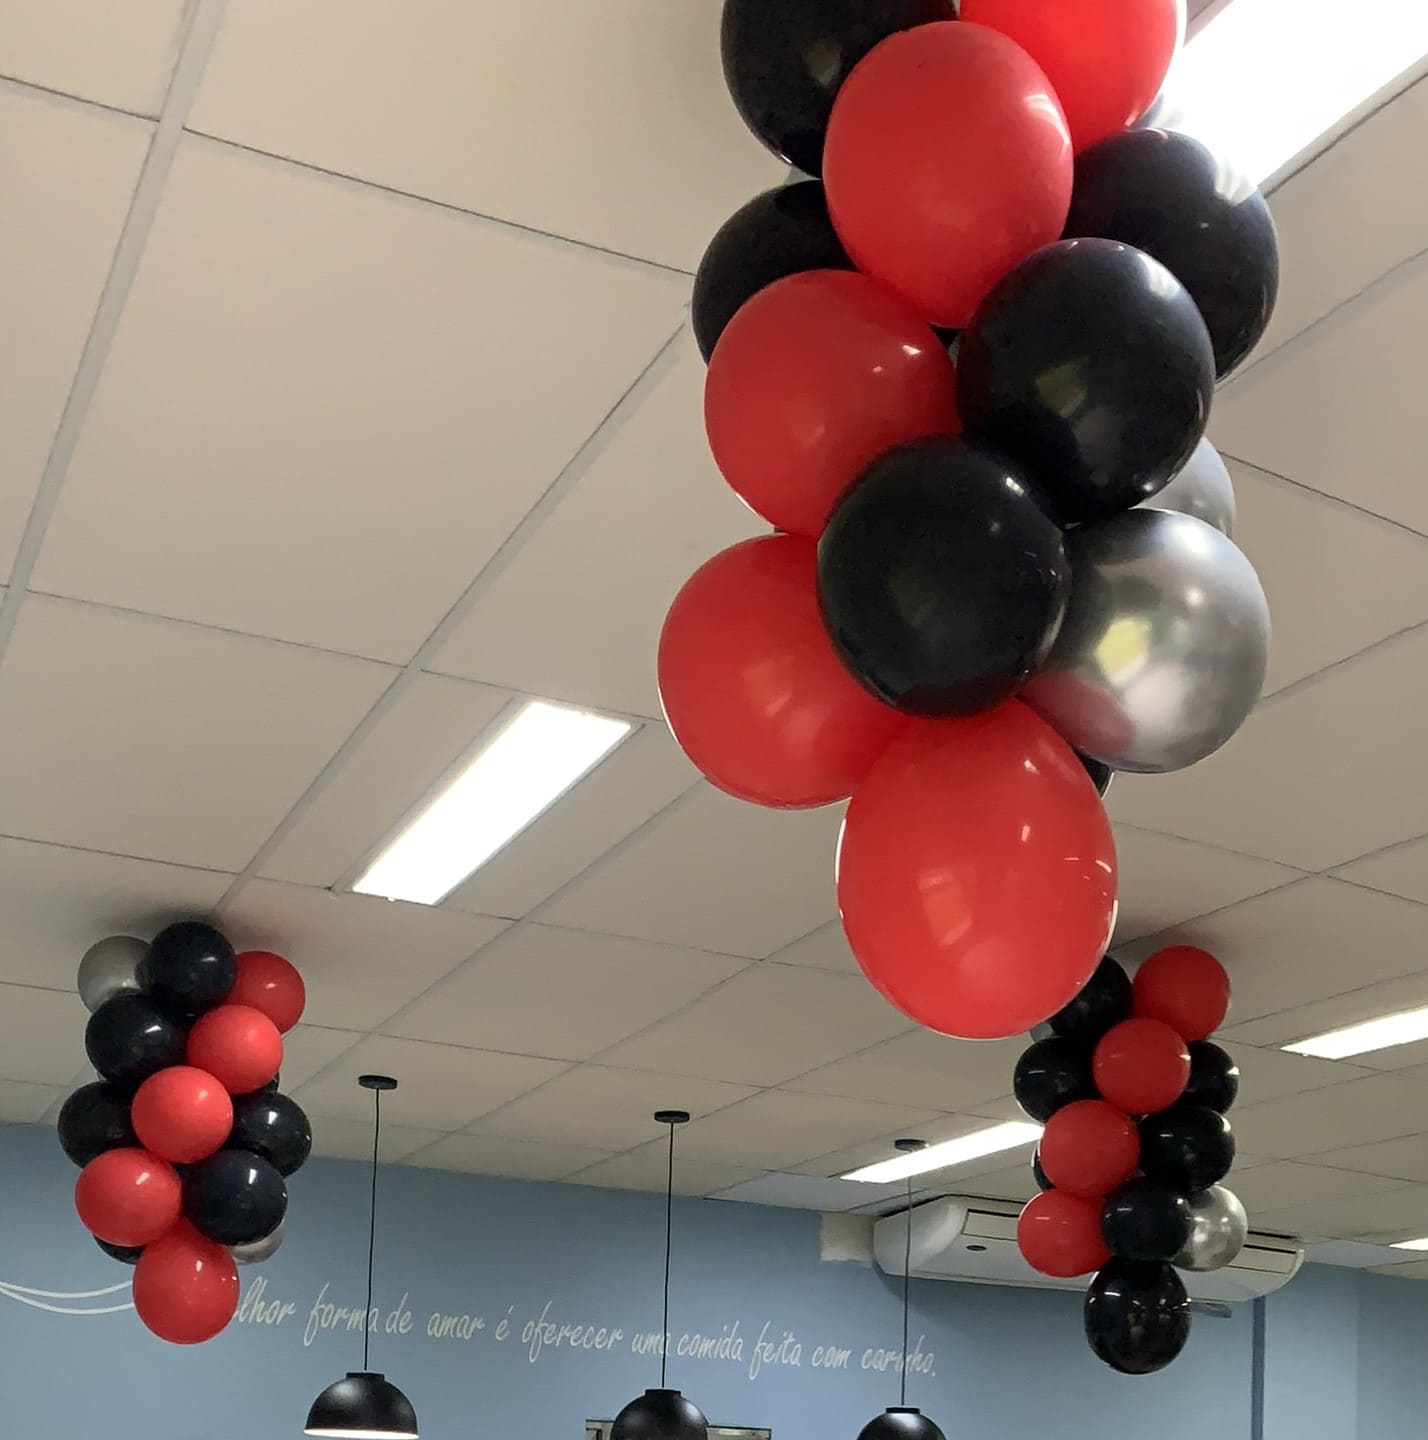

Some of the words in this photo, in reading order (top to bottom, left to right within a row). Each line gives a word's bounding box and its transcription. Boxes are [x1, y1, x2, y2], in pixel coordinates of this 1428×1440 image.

[234, 1276, 296, 1325] lhor
[304, 1282, 378, 1346] forma
[386, 1292, 413, 1334] de
[427, 1312, 485, 1340] amar
[495, 1305, 514, 1341] é
[522, 1301, 624, 1363] oferecer
[632, 1332, 670, 1356] uma
[677, 1320, 744, 1362] comida
[749, 1321, 802, 1381] feita
[812, 1345, 851, 1369] com
